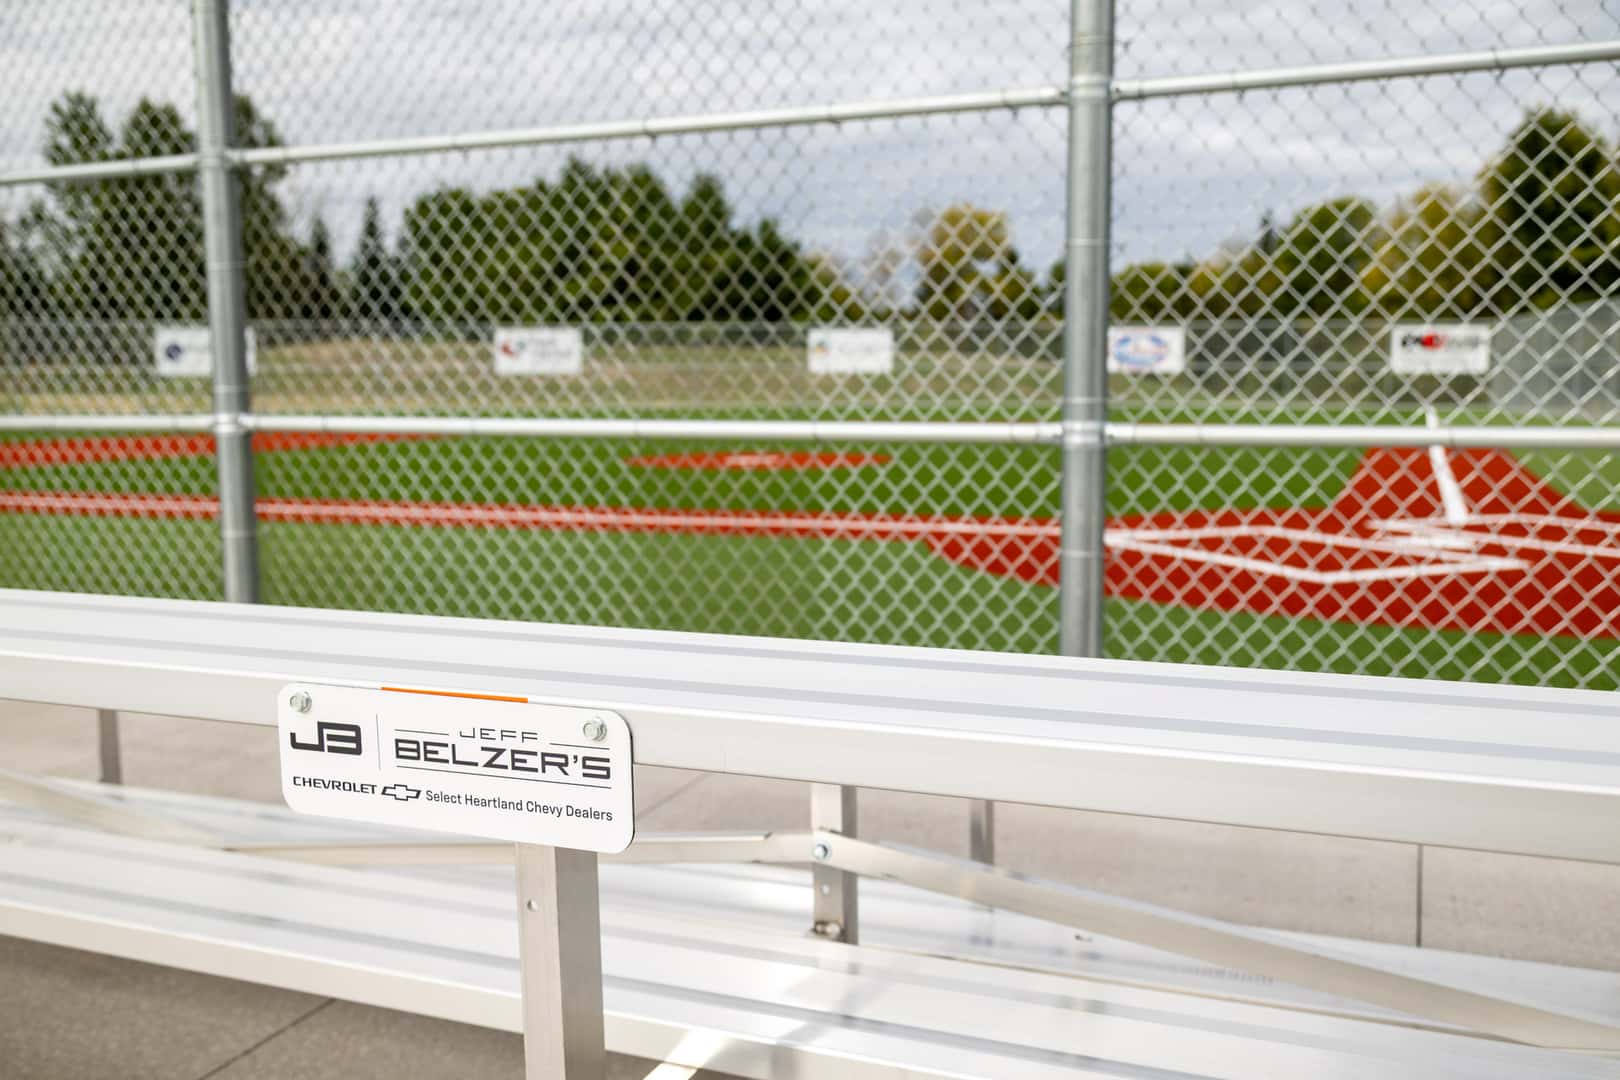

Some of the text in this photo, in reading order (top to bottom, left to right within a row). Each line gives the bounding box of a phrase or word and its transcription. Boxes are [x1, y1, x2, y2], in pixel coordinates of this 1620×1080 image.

[459, 727, 539, 744] JEFF
[394, 738, 611, 780] BELZER'S
[292, 776, 613, 822] CHEVROLET Select Heartland Chevy Dealers
